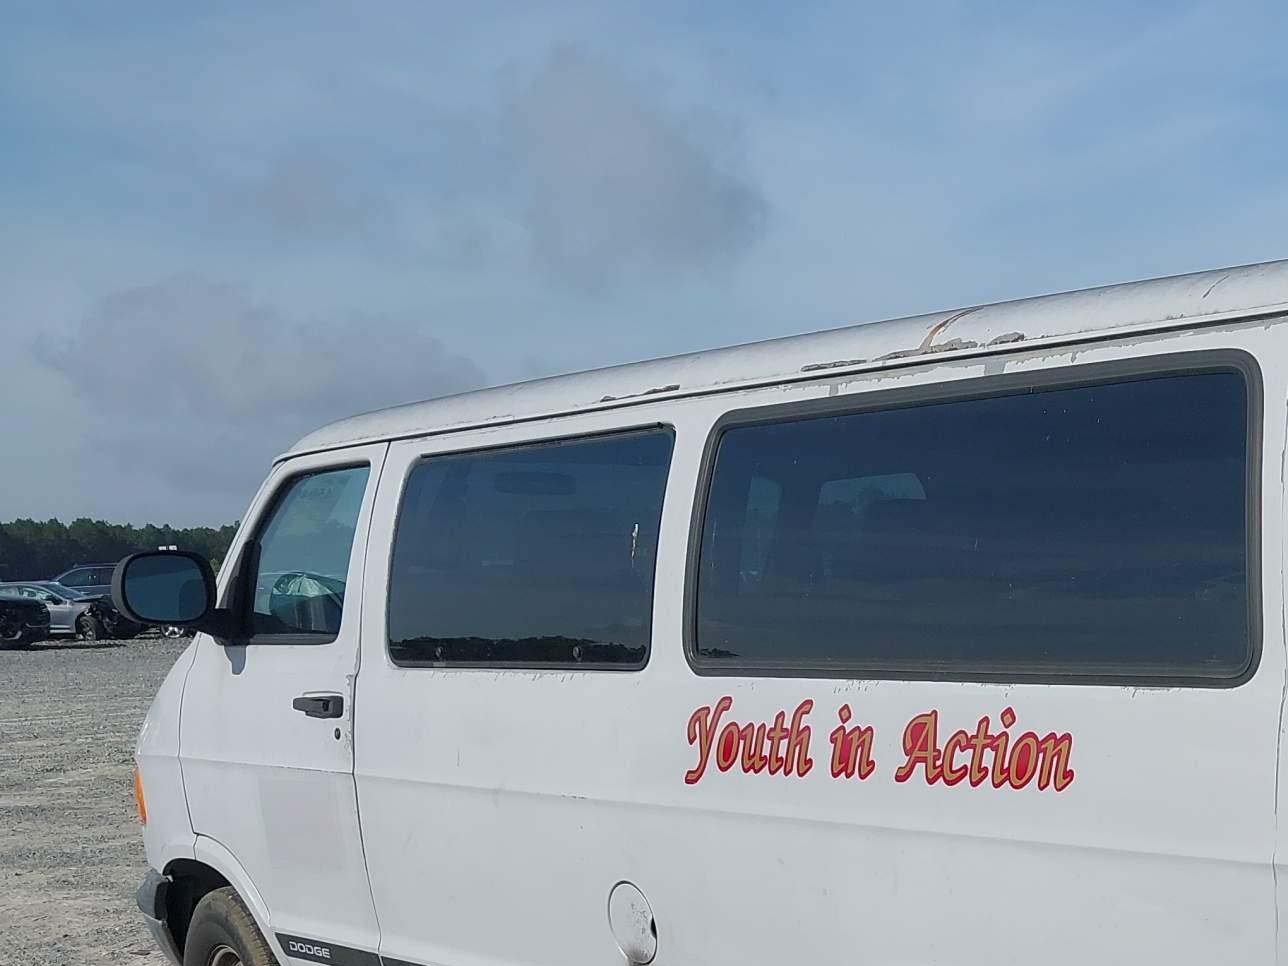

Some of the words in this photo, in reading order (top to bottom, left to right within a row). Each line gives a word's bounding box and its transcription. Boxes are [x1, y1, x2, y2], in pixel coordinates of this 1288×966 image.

[685, 696, 814, 785] Youth
[830, 703, 876, 781] in
[894, 706, 1075, 792] Action
[288, 941, 331, 958] DODGE
